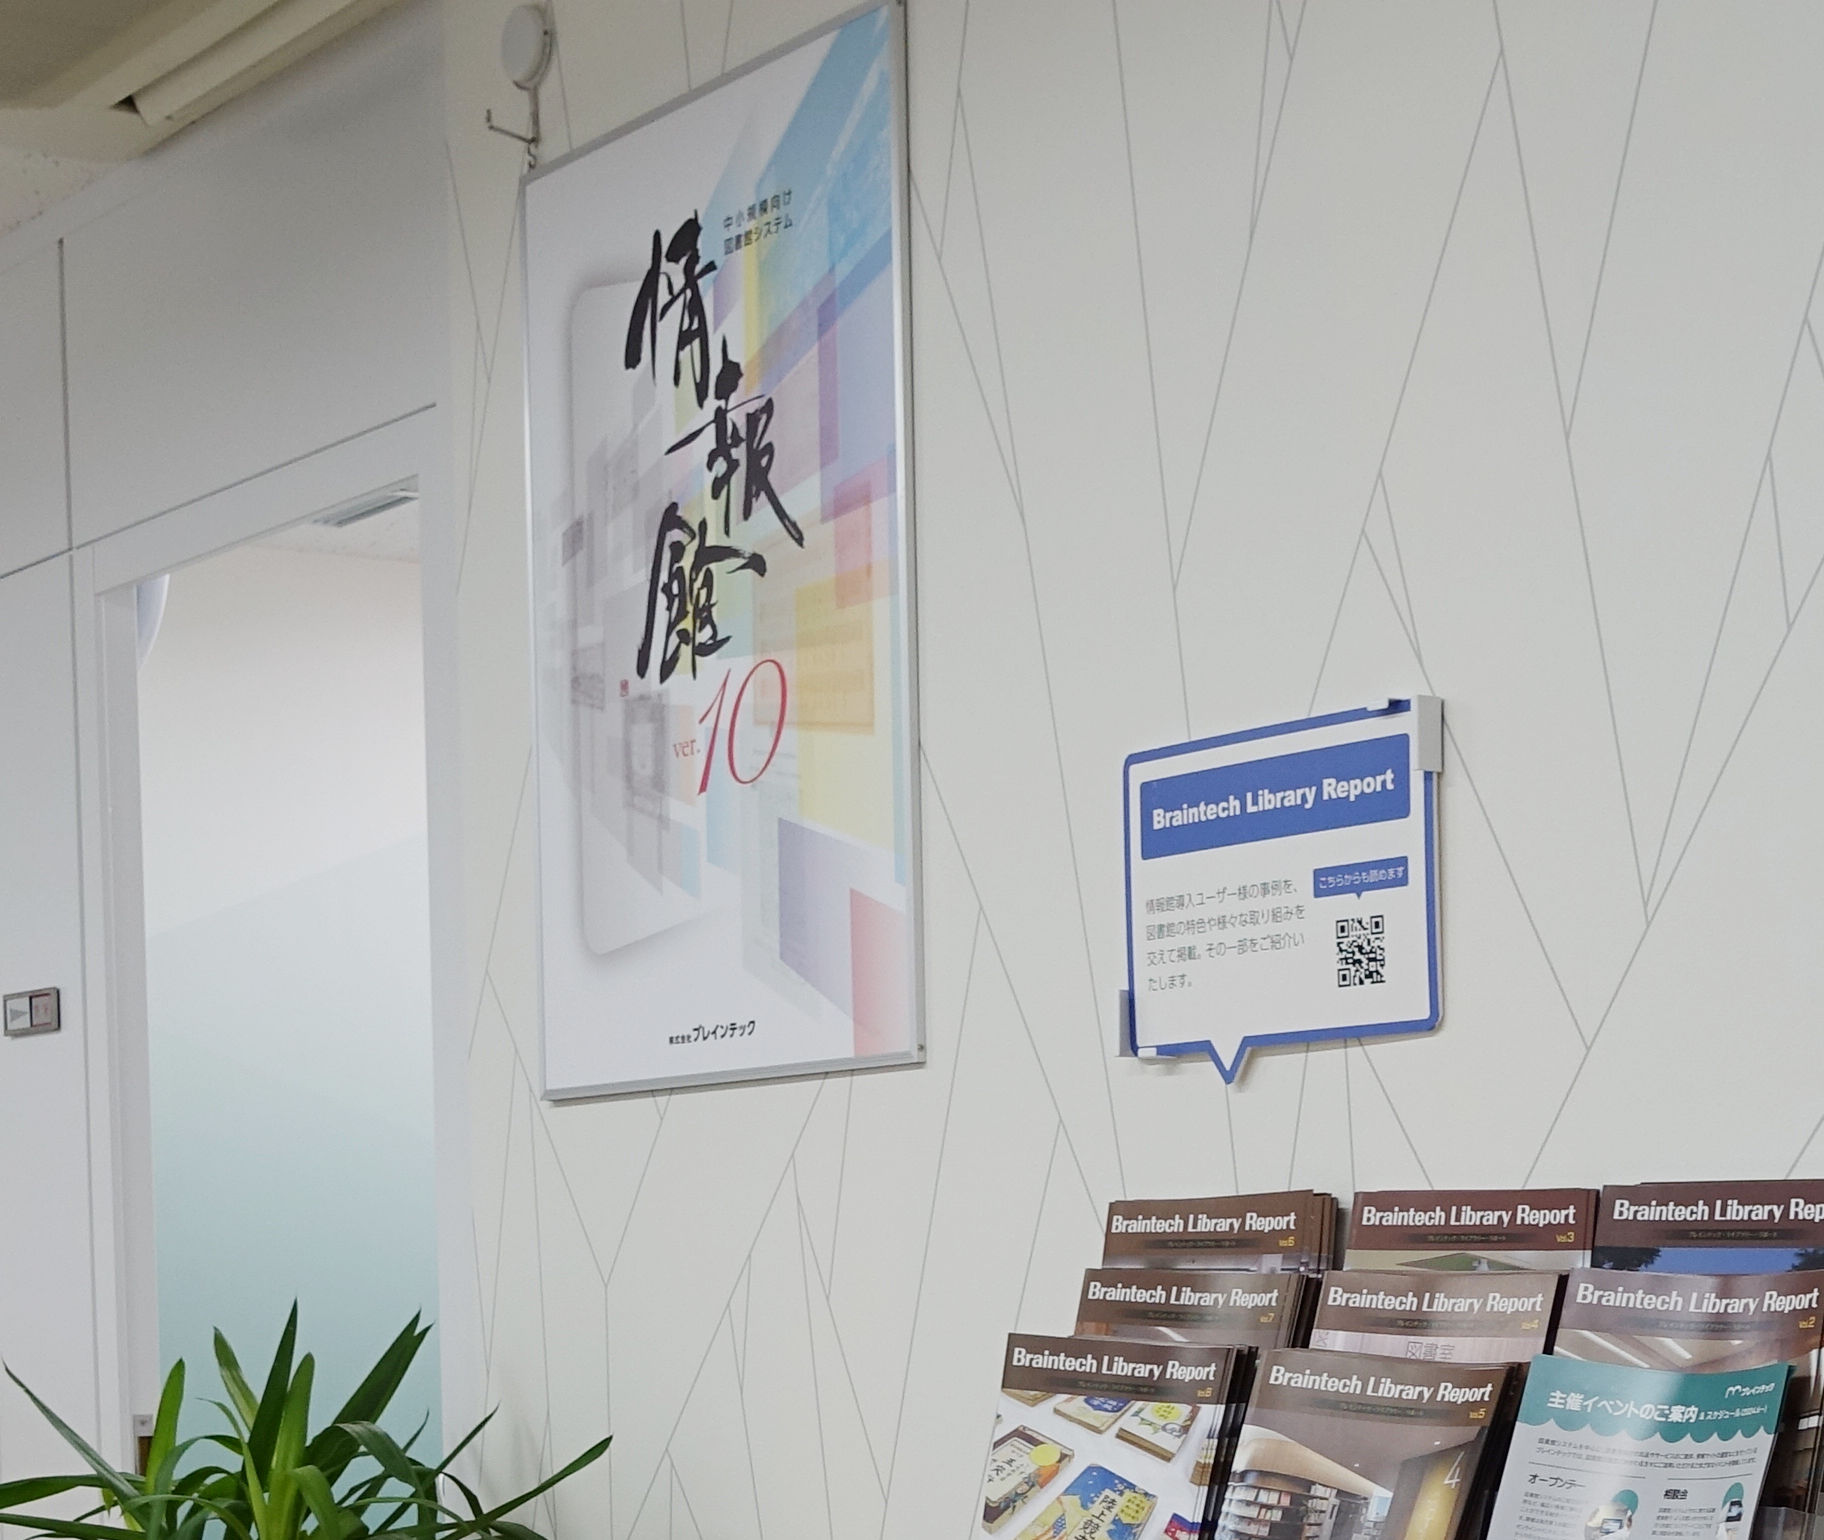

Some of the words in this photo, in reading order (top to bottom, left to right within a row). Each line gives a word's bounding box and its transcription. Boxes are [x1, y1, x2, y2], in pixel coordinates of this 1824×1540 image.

[723, 213, 794, 256] 図書館システム
[672, 736, 702, 760] ver.
[698, 658, 788, 796] 10
[1152, 794, 1241, 831] Braintech
[1245, 784, 1318, 816] Library
[1321, 767, 1395, 802] Report
[1318, 866, 1406, 890] こちらからも読めます
[1145, 878, 1298, 916] 情報館導入ユーザー様の事例を、
[1145, 904, 1306, 942] 図書館の特色や様々な取り組みを
[1146, 931, 1305, 967] 交えて掲載。その一部をご紹介い
[1147, 974, 1193, 992] たします。
[1111, 1214, 1184, 1234] Braintech
[1187, 1214, 1242, 1234] Library
[1244, 1212, 1297, 1234] Report
[1361, 1205, 1444, 1228] Braintech
[1449, 1205, 1513, 1229] Library
[1516, 1204, 1577, 1227] Report
[1612, 1199, 1709, 1224] Braintech
[1712, 1198, 1784, 1224] Library
[1555, 1230, 1576, 1244] Vol.3
[1087, 1280, 1167, 1304] Braintech
[1169, 1285, 1227, 1309] Library
[1229, 1288, 1279, 1310] Report
[1327, 1286, 1419, 1311] Braintech
[1422, 1292, 1484, 1316] Library
[1486, 1292, 1544, 1314] Report
[1576, 1283, 1683, 1312] Braintech
[1688, 1291, 1759, 1316] Library
[1761, 1287, 1820, 1314] Report
[1011, 1347, 1098, 1374] Braintech
[1101, 1355, 1163, 1381] Library
[1165, 1359, 1217, 1383] Report
[1270, 1365, 1360, 1398] Braintech
[1365, 1374, 1434, 1403] Library
[1436, 1381, 1494, 1403] Report
[1546, 1390, 1699, 1424] 主催イベントのご案内
[1528, 1473, 1586, 1488] オープンデー
[1663, 1488, 1688, 1500] 相談会
